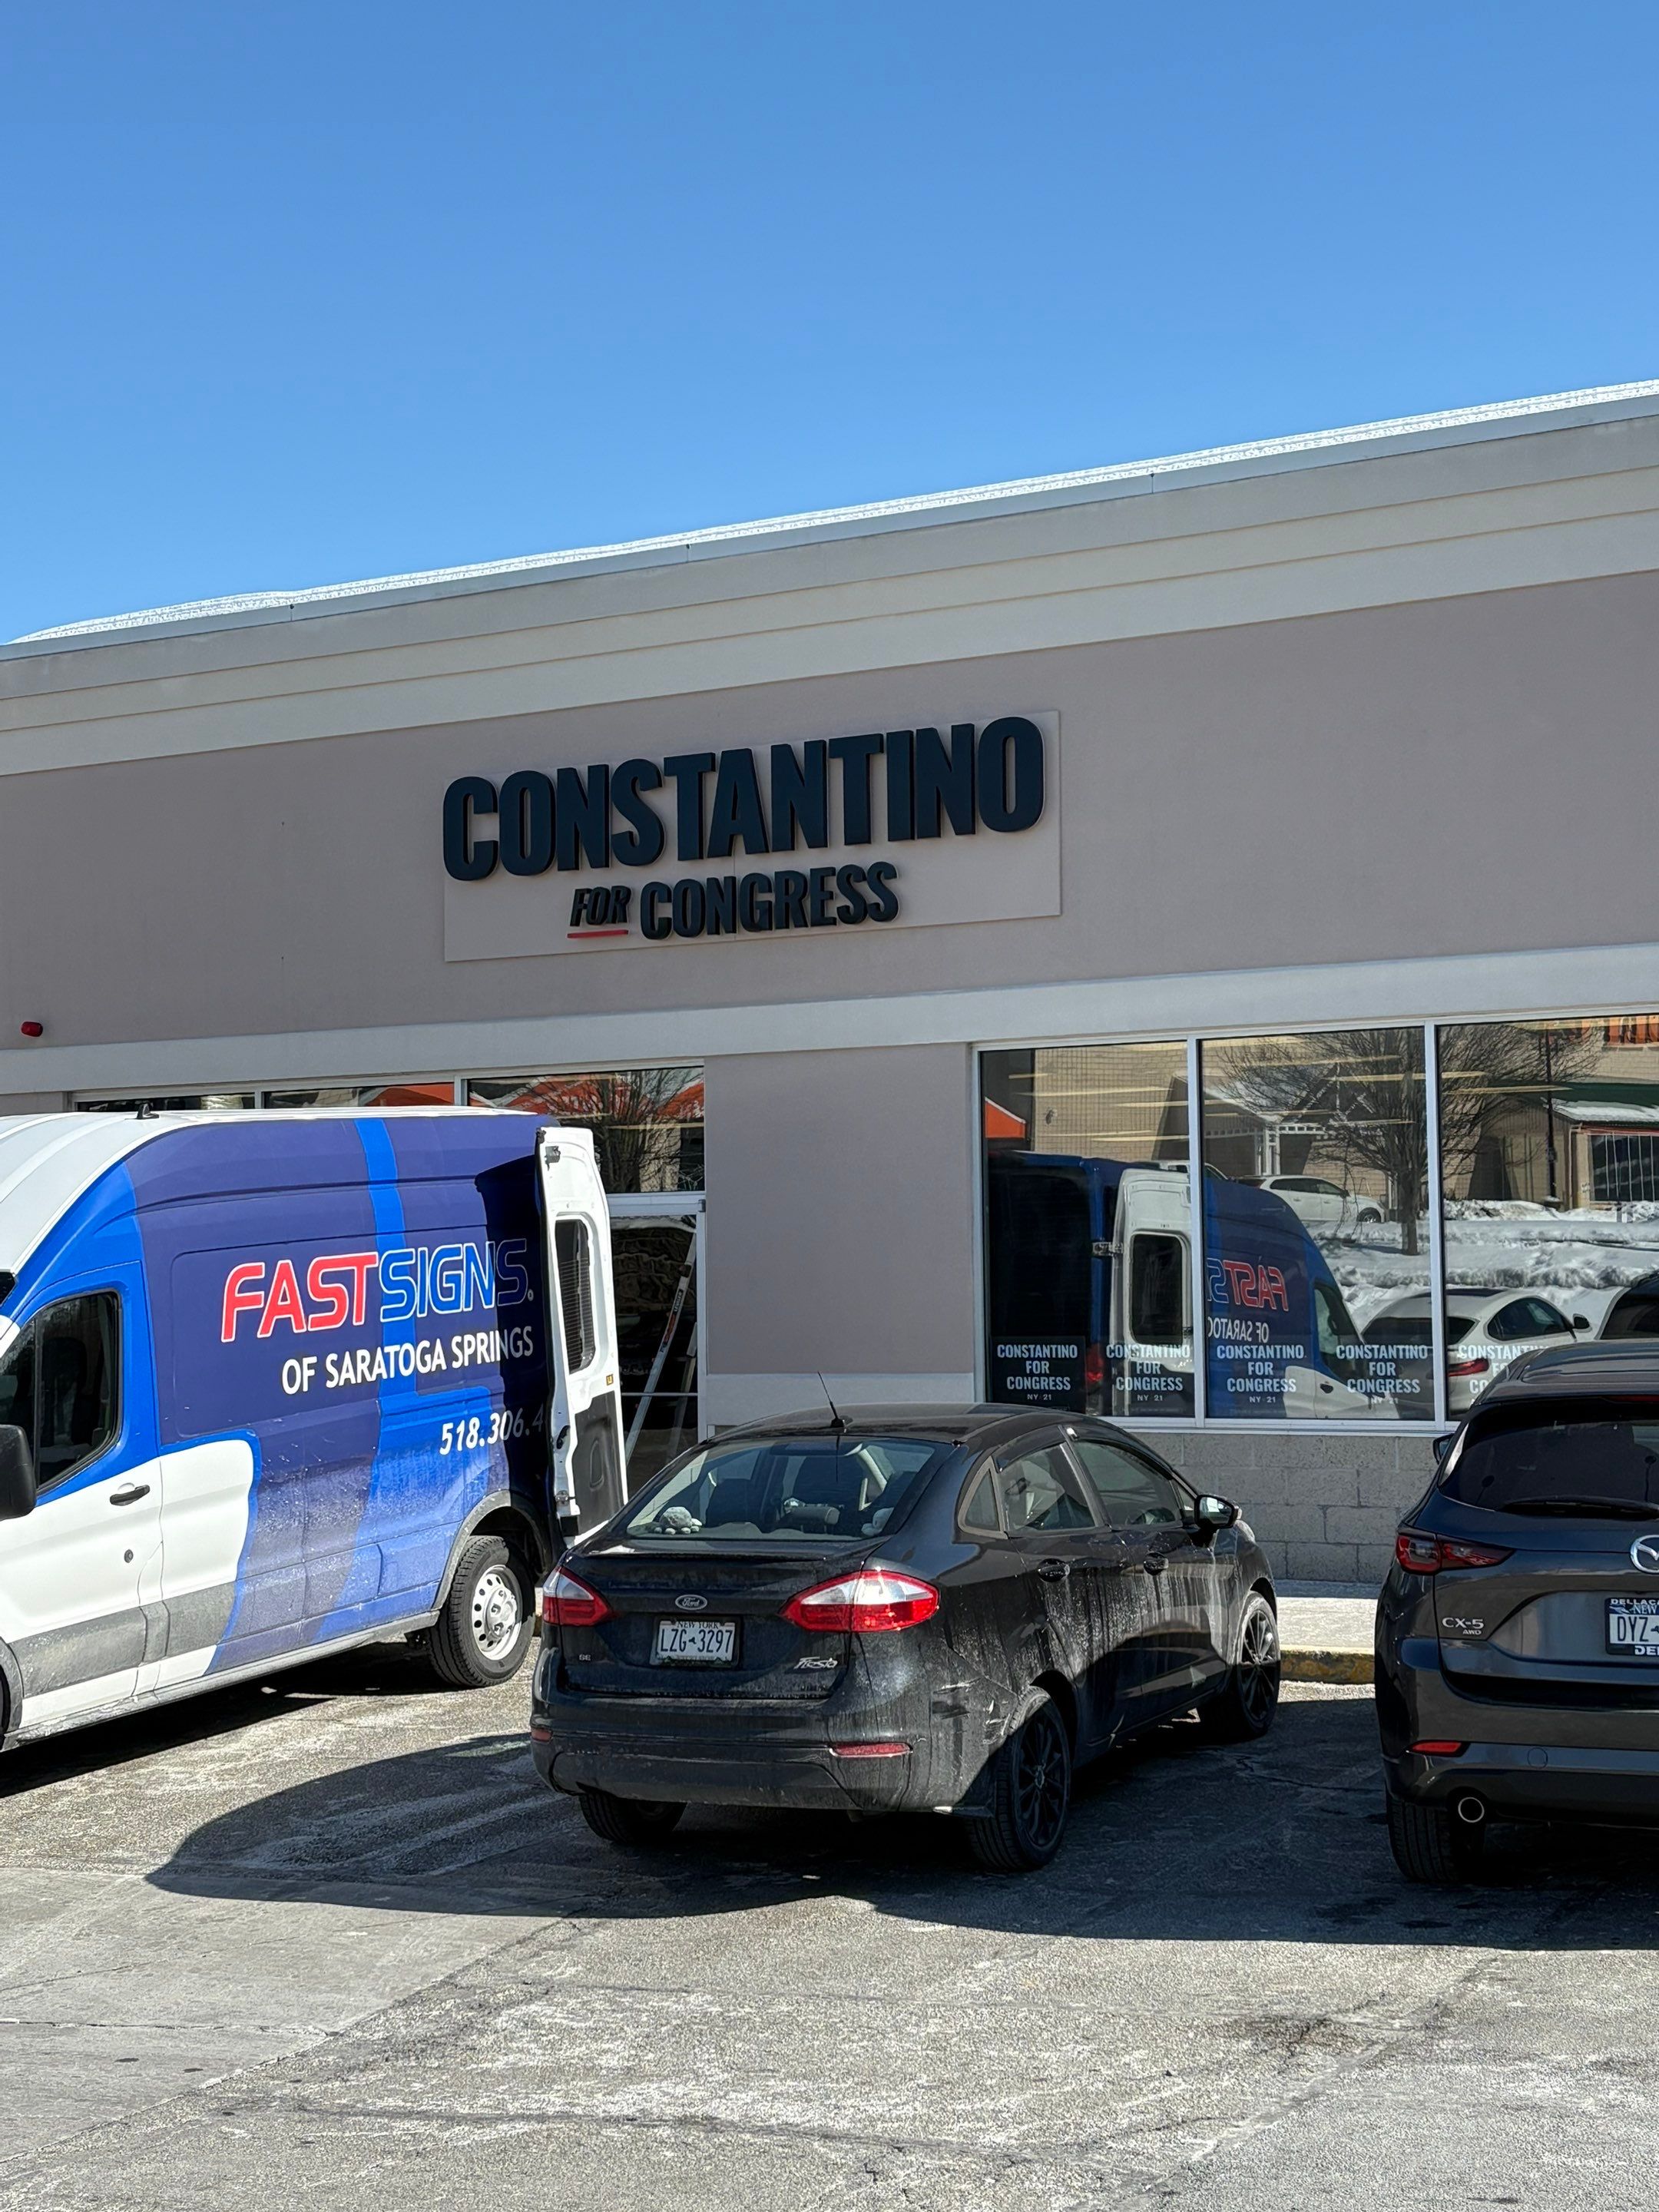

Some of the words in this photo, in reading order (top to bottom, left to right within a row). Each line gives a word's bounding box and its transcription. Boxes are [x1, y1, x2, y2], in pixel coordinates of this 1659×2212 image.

[443, 716, 1044, 881] CONSTANTINO
[569, 886, 631, 926] FOR
[640, 861, 899, 939] CONGRESS
[997, 1344, 1078, 1359] CONSTANTINO
[1106, 1344, 1190, 1359] CONSTANTINO
[1217, 1344, 1304, 1359] CONSTANTINO
[1336, 1345, 1428, 1359] CONSTANTINO
[282, 1356, 318, 1395] OF
[325, 1338, 446, 1389] SARATOGA
[452, 1326, 534, 1369] SPRINGS
[1025, 1360, 1050, 1374] FOR
[1137, 1361, 1161, 1374] FOR
[1247, 1362, 1273, 1376] FOR
[1369, 1362, 1396, 1376] FOR
[1006, 1376, 1071, 1391] CONGRESS
[1116, 1377, 1183, 1391] CONGRESS
[1227, 1378, 1296, 1392] CONGRESS
[1347, 1379, 1421, 1393] CONGRESS
[1634, 1604, 1657, 1614] NEW
[1442, 1618, 1484, 1629] CX-5
[1617, 1616, 1649, 1642] DYZ
[1634, 1645, 1659, 1655] DE
[793, 1656, 838, 1670] Fiesta
